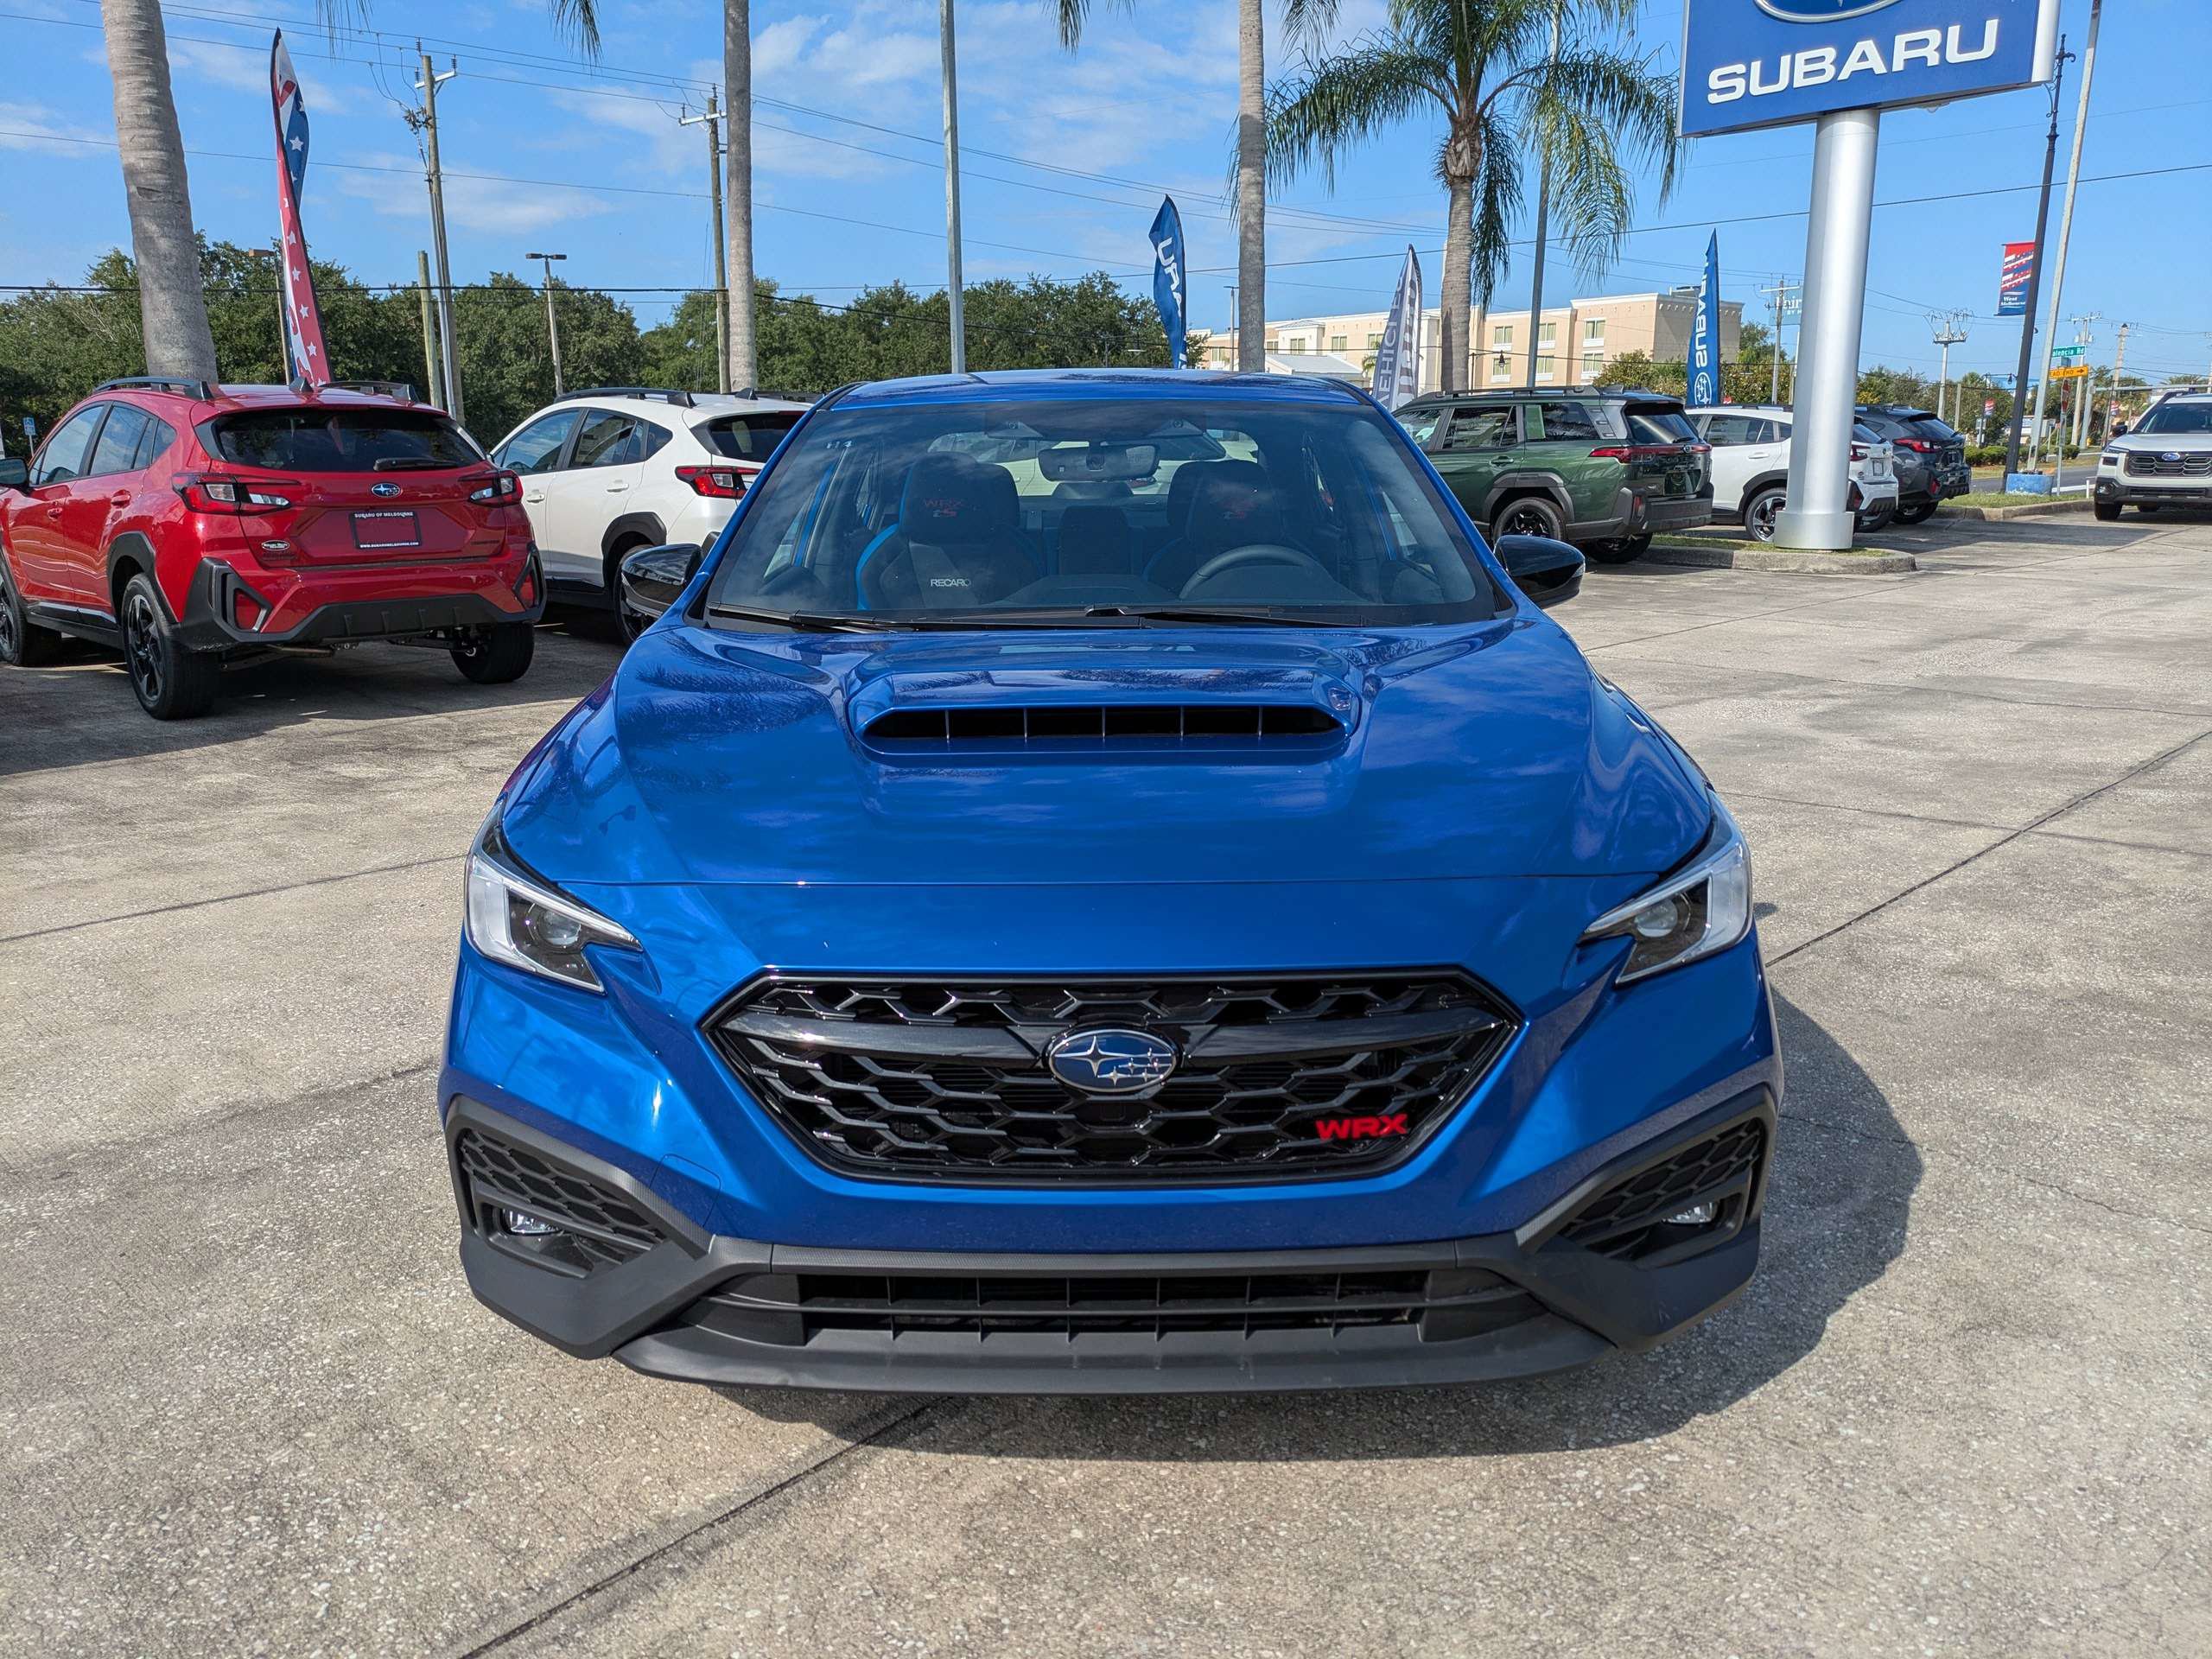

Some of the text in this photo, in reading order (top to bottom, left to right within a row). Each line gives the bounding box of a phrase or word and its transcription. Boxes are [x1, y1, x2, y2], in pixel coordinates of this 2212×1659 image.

[1707, 19, 1999, 104] SUBARU
[931, 578, 971, 588] RECARO
[1316, 1113, 1408, 1141] WRX
